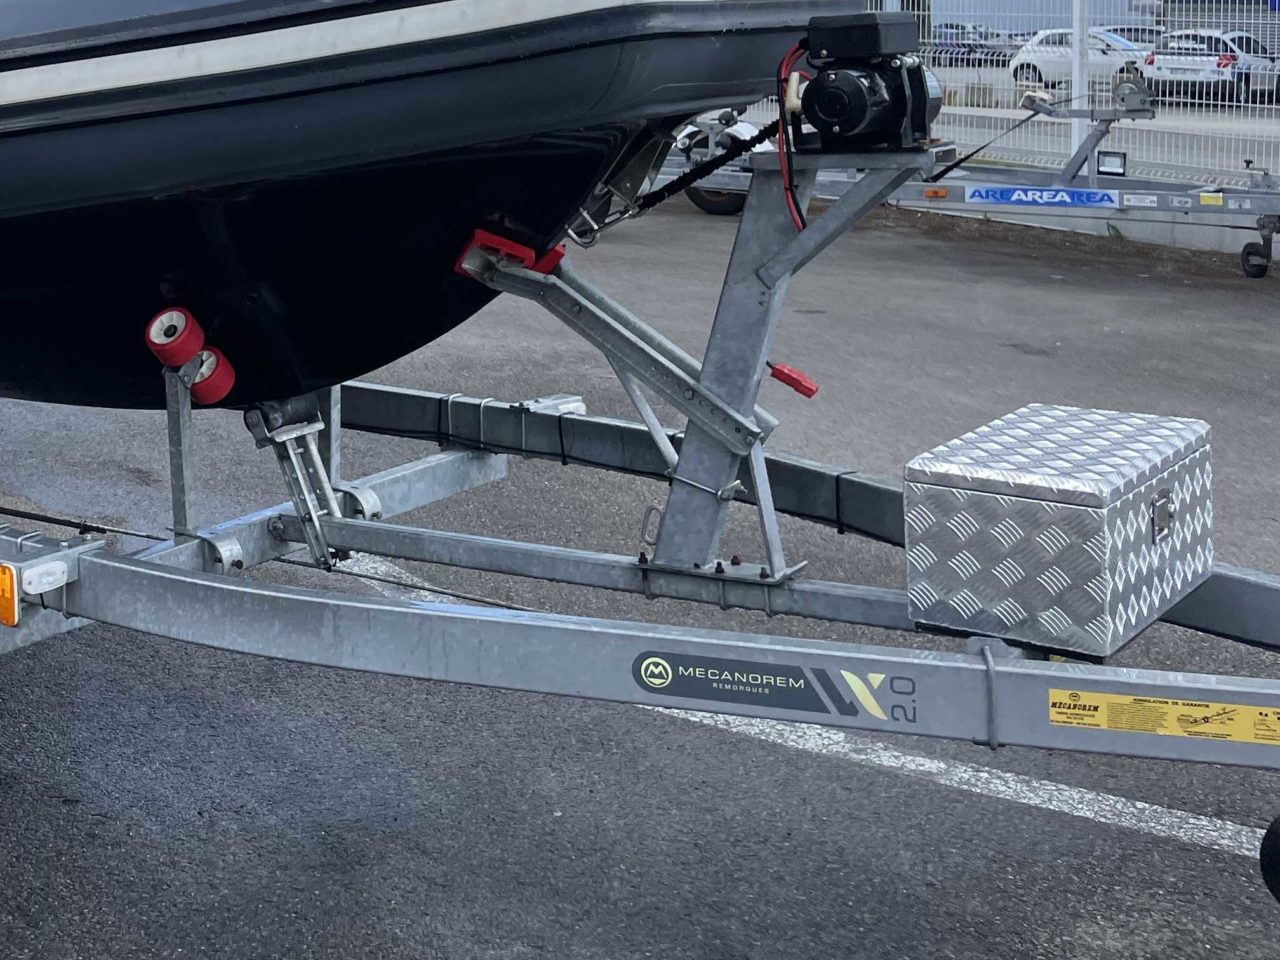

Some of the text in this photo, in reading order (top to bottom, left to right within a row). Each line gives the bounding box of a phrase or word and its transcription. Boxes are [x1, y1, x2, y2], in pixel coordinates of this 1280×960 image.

[1010, 190, 1072, 204] AREA
[677, 665, 805, 689] MECANOREM
[712, 681, 770, 694] REMORQUES
[889, 676, 918, 724] 2.0
[1050, 701, 1100, 713] MECANOREM
